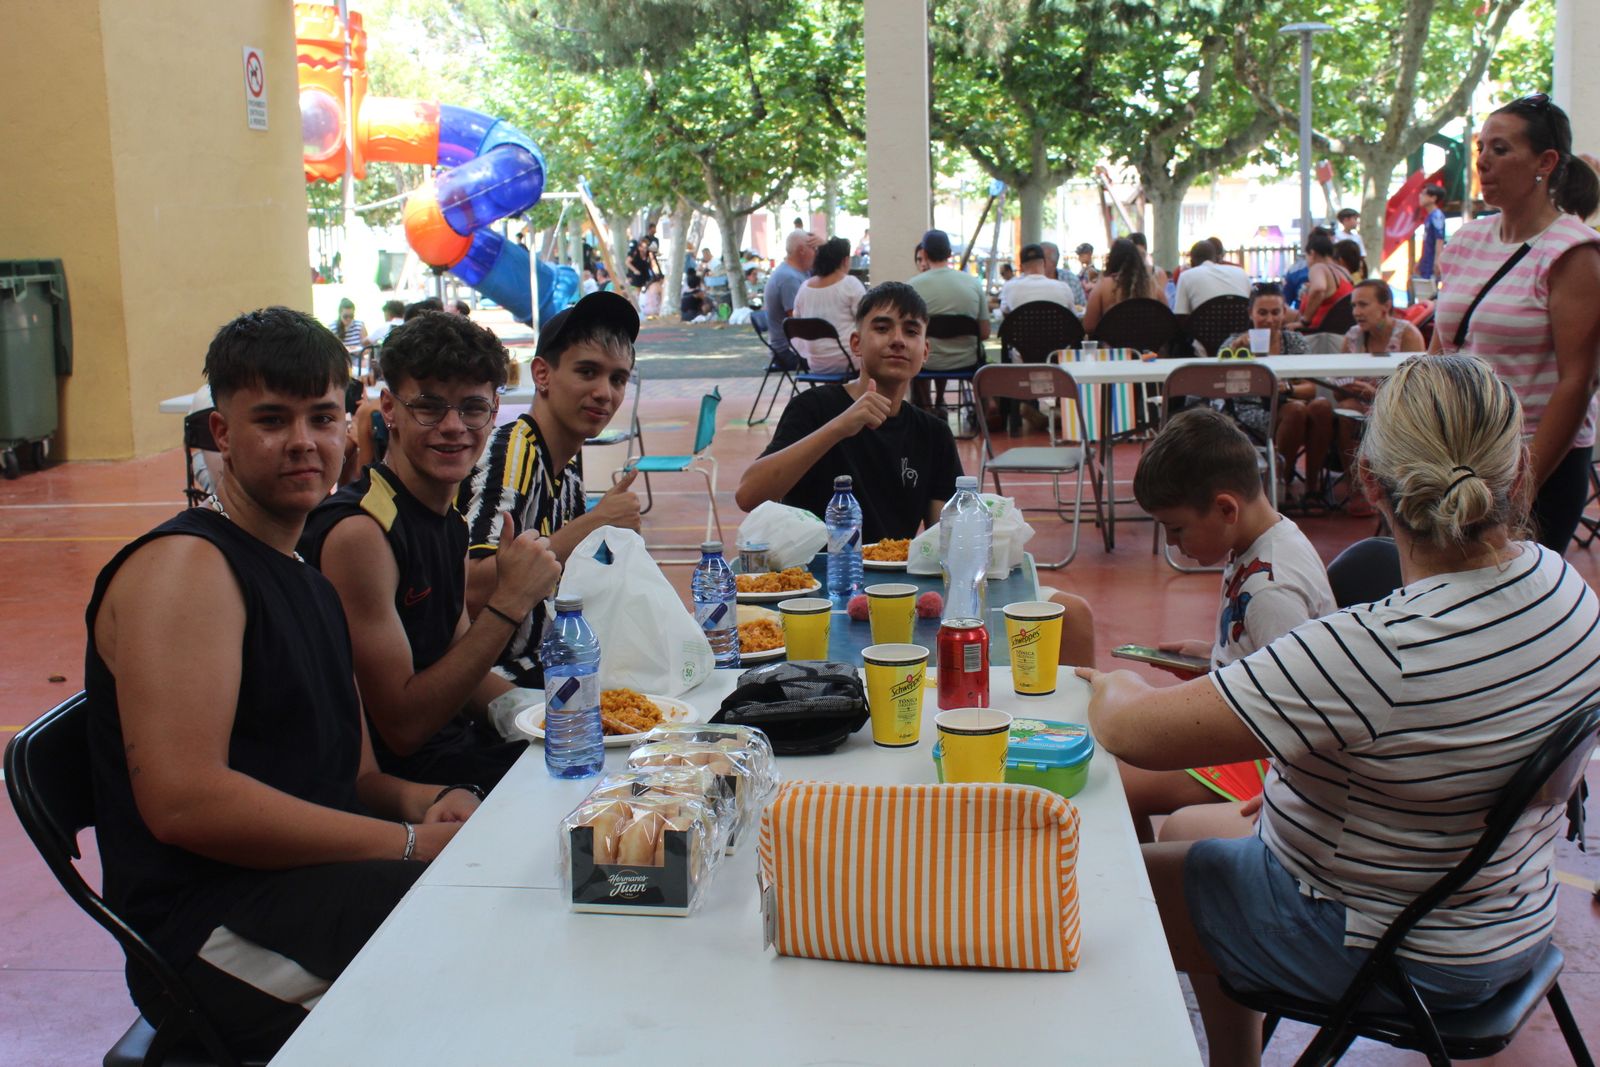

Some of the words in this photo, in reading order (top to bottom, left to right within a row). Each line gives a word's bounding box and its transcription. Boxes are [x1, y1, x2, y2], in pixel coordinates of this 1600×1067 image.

[1011, 630, 1040, 646] Schweppes
[891, 674, 923, 697] Schweppes
[608, 874, 648, 884] Hermanos
[609, 882, 647, 897] Juan
